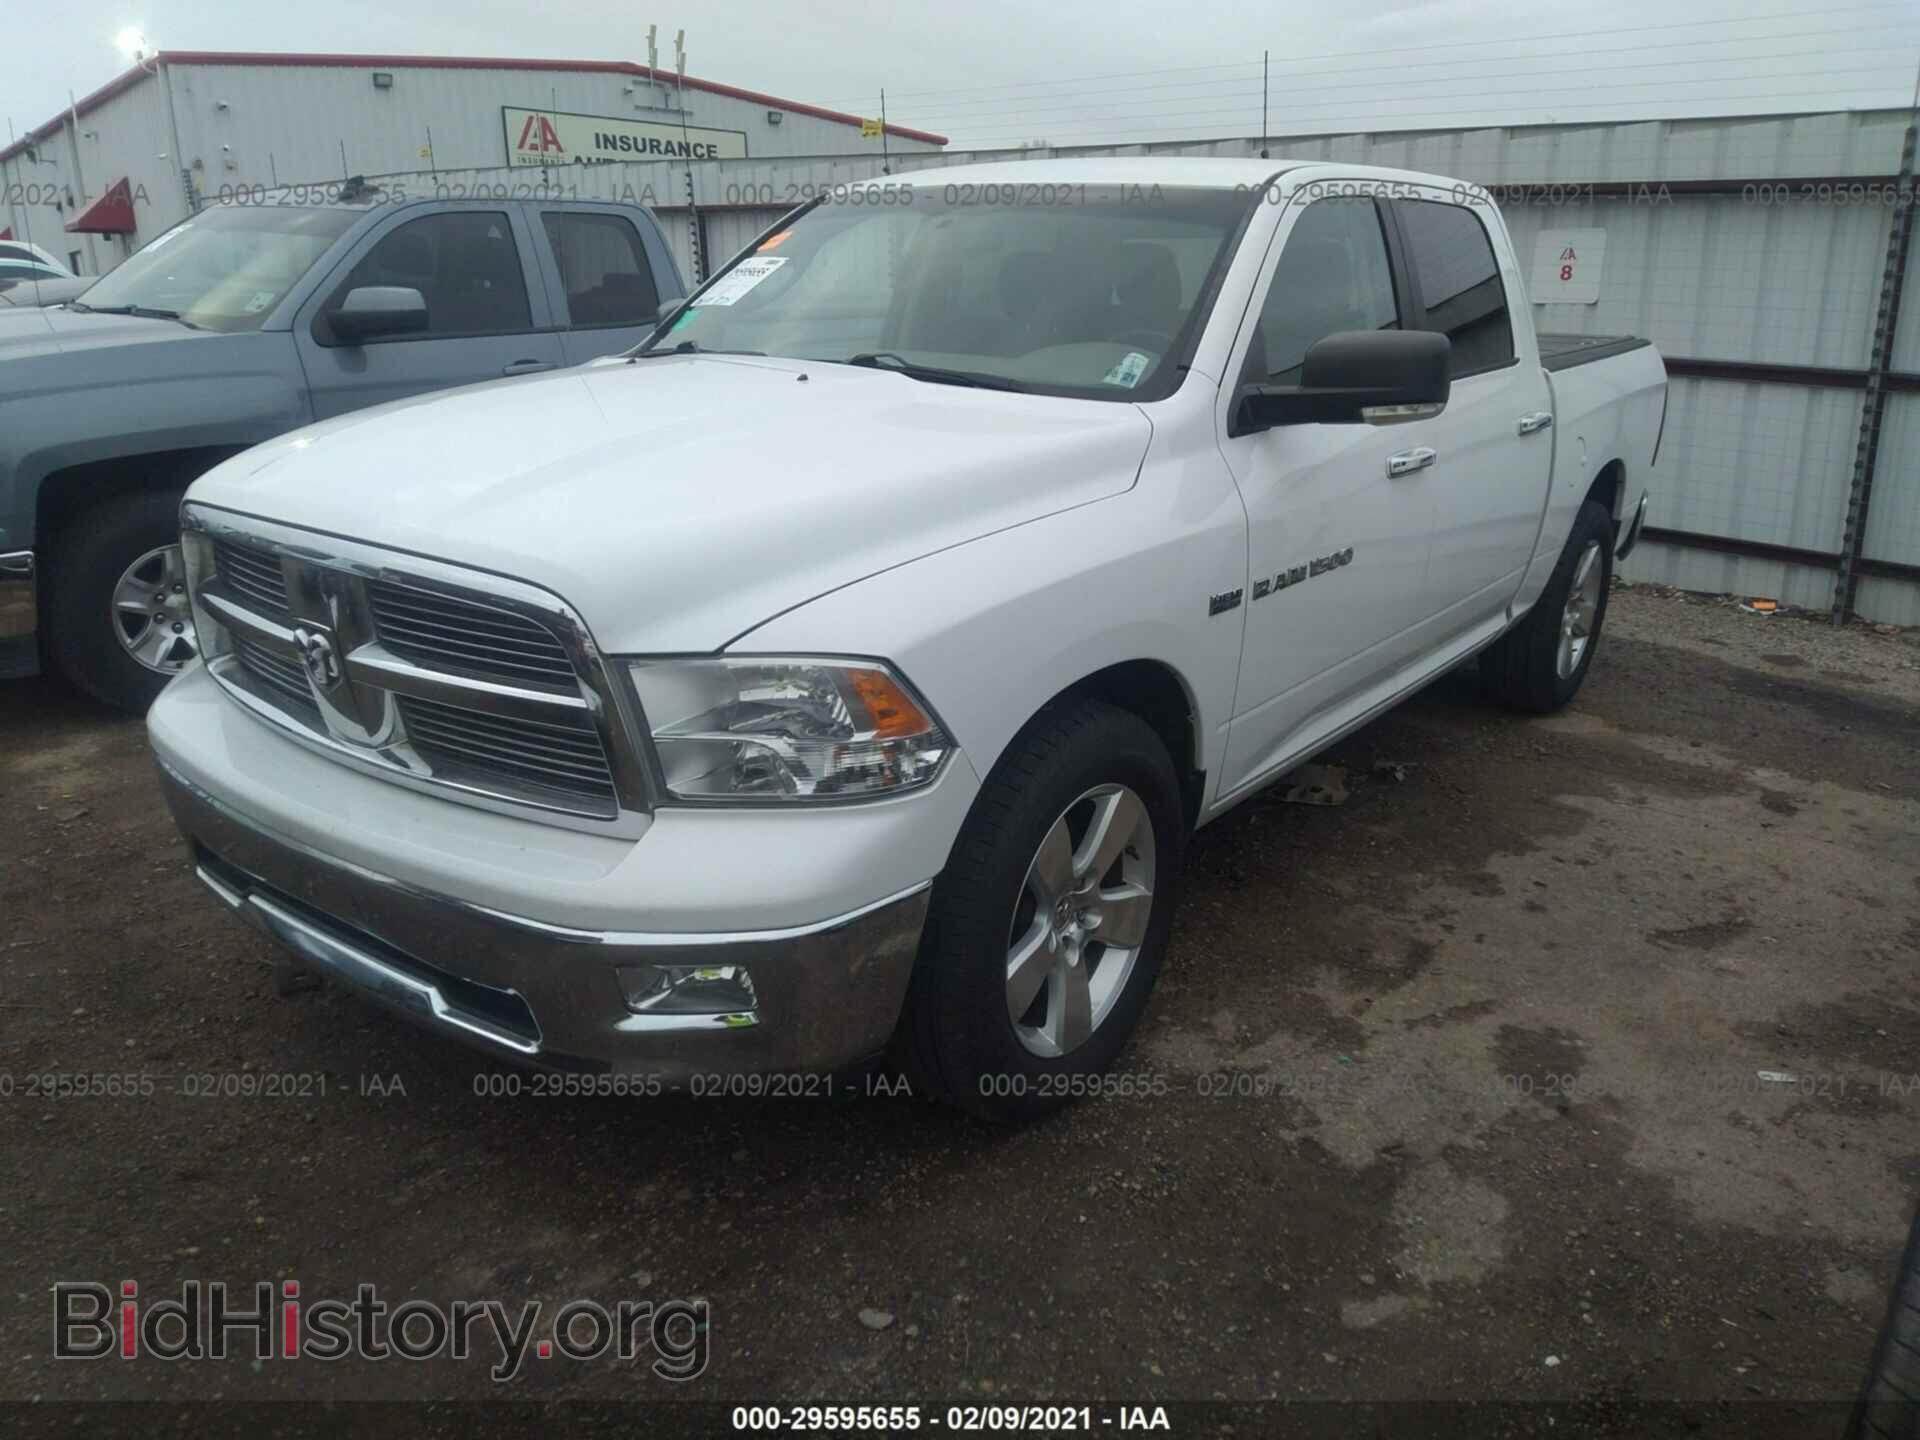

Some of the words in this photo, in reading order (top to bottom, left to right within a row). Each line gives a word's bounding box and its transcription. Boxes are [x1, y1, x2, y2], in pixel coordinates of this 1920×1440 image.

[594, 131, 718, 160] INSURANCE
[1559, 265, 1573, 281] 8
[1252, 565, 1308, 601] RAM
